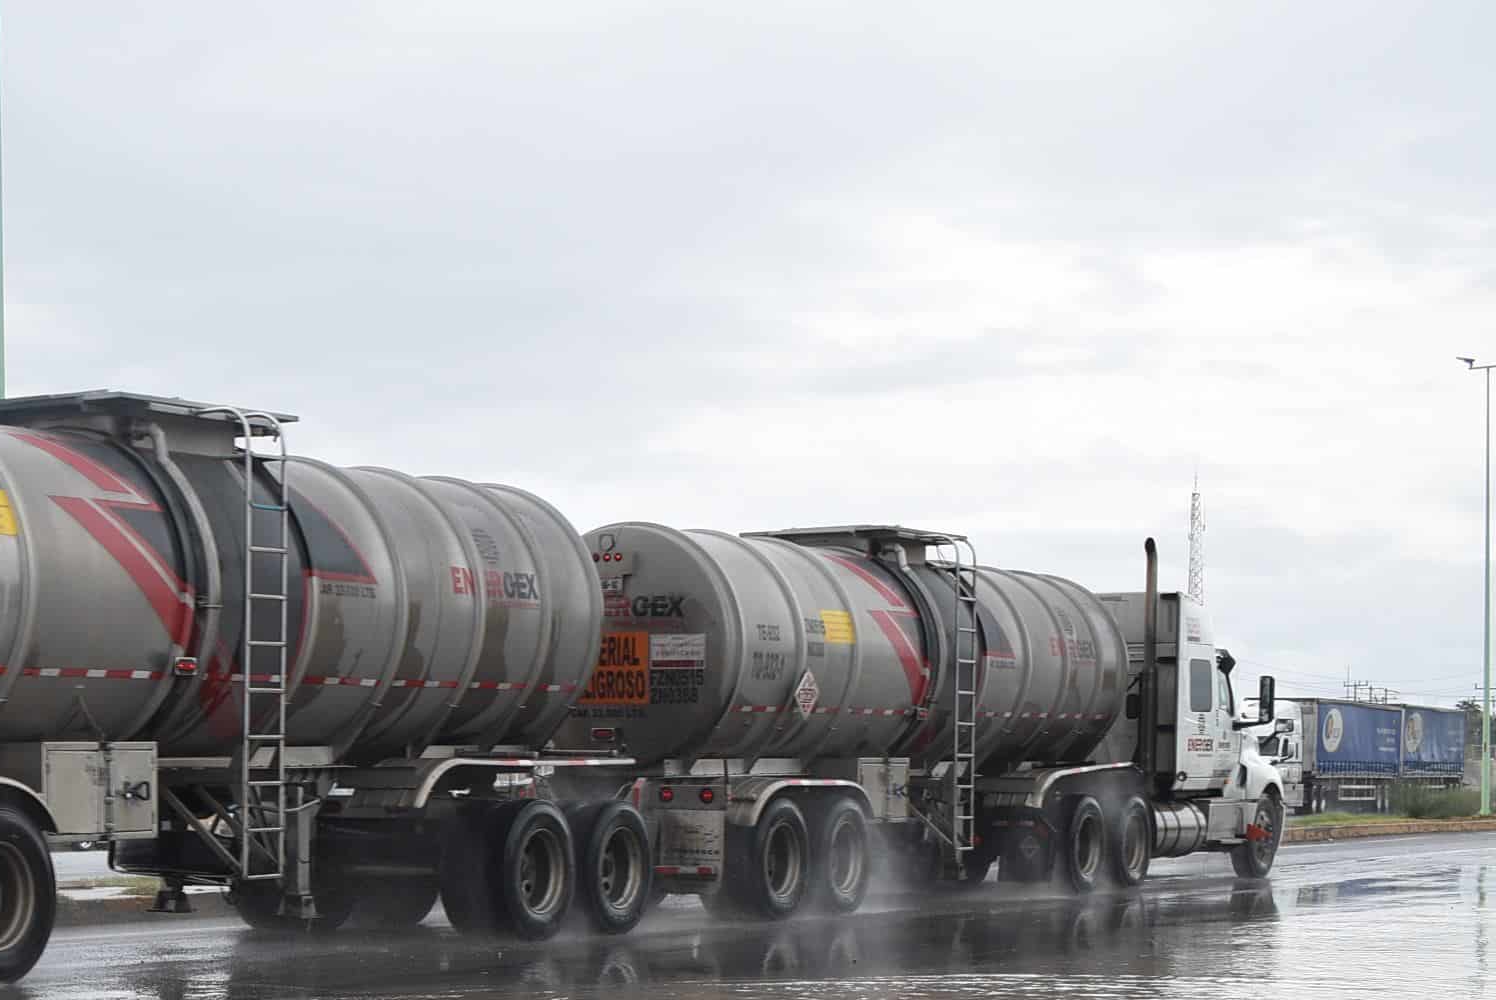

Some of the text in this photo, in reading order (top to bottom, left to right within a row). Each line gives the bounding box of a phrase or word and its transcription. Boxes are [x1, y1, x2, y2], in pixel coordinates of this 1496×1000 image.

[602, 594, 685, 617] ERGEX
[599, 636, 641, 666] ERIAL
[584, 670, 645, 699] IGROSO
